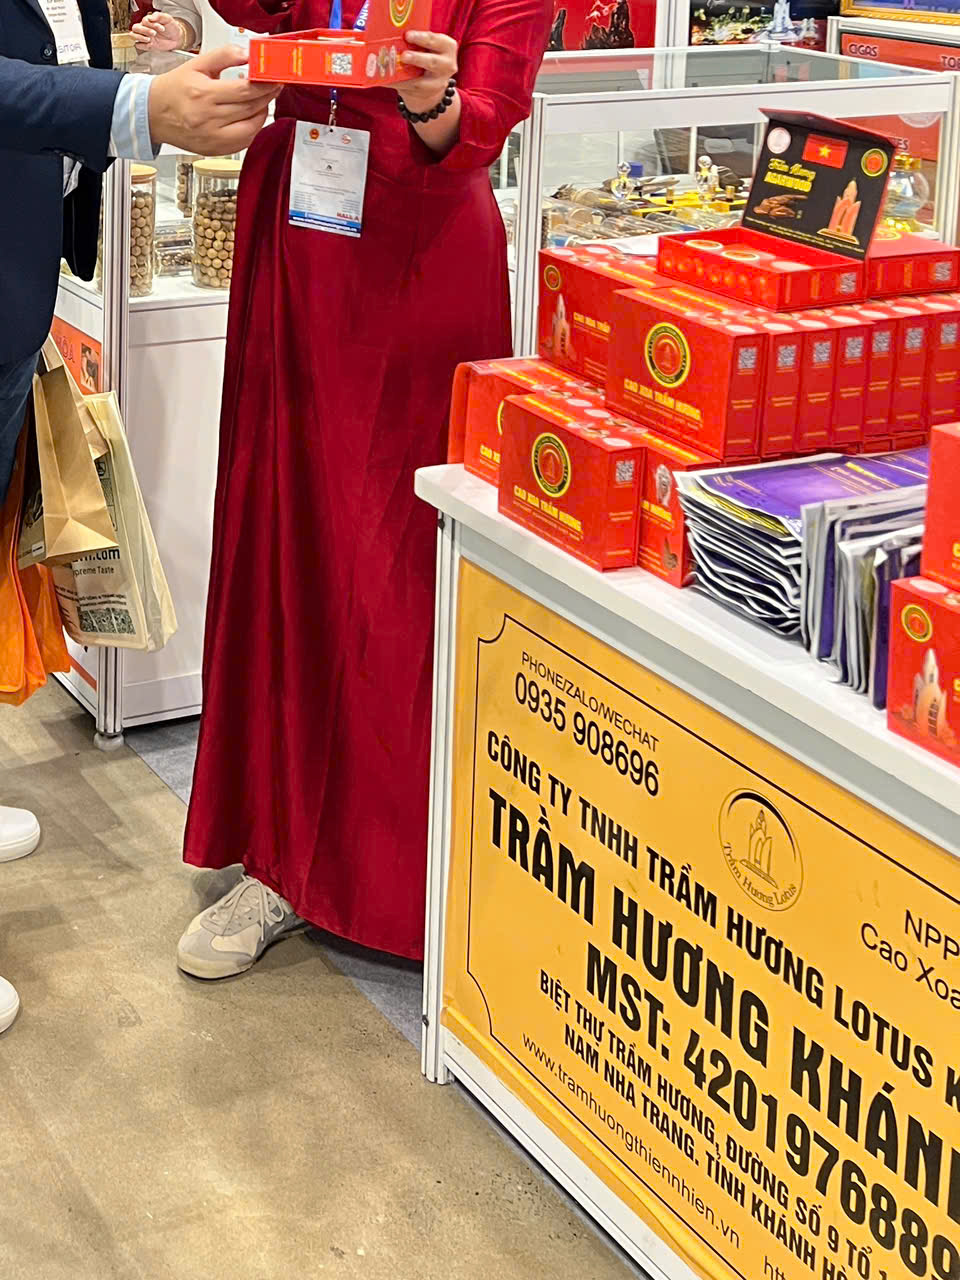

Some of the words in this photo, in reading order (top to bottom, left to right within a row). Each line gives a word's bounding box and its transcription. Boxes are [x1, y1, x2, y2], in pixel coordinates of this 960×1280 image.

[515, 672, 566, 732] 0935
[573, 711, 659, 797] 908696
[521, 650, 660, 753] PHONE/ZALO/WECHAT
[487, 730, 541, 796] CÔNG
[548, 773, 572, 816] TY
[578, 795, 638, 870] TNHH
[646, 845, 717, 930] TRẦM
[727, 905, 824, 1010] HƯƠNG
[834, 985, 933, 1088] LOTUS
[489, 787, 595, 927] TRẦM
[612, 885, 769, 1069] HƯƠNG
[861, 923, 908, 972] Cao
[905, 909, 960, 960] NPP
[586, 941, 671, 1062] MST:
[522, 1032, 740, 1249] www.tramhuongthiennhien.vn
[540, 968, 571, 1012] BIỆT
[575, 1000, 605, 1048] THỰ
[726, 1134, 789, 1211] ĐƯỜNG
[827, 1225, 839, 1254] 9
[565, 1023, 600, 1074] NAM
[604, 1059, 636, 1108] NHA
[641, 1092, 699, 1167] TRANG.
[751, 1192, 816, 1272] KHÁNH
